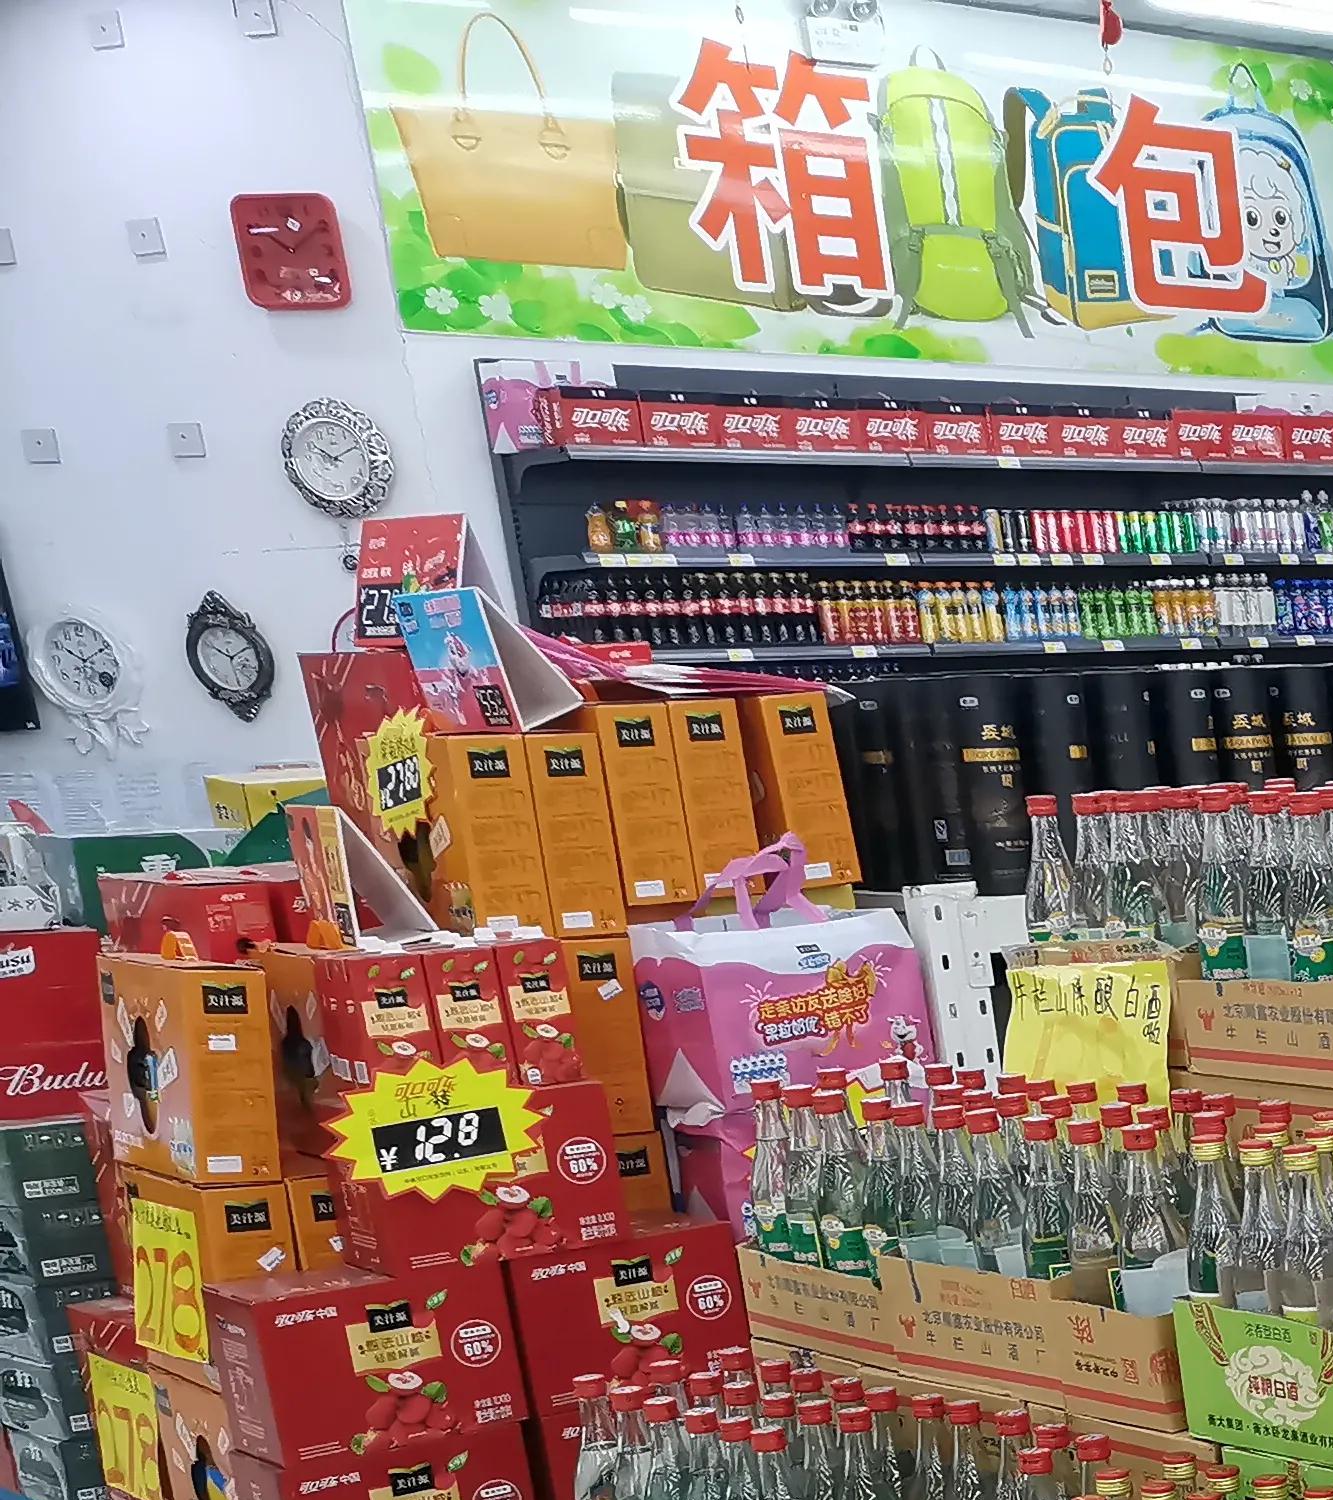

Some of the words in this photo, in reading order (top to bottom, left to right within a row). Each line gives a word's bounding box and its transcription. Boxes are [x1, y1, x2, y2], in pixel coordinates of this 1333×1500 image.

[568, 1159, 599, 1175] 60%
[697, 1294, 725, 1311] 60%
[464, 1340, 494, 1357] 60%
